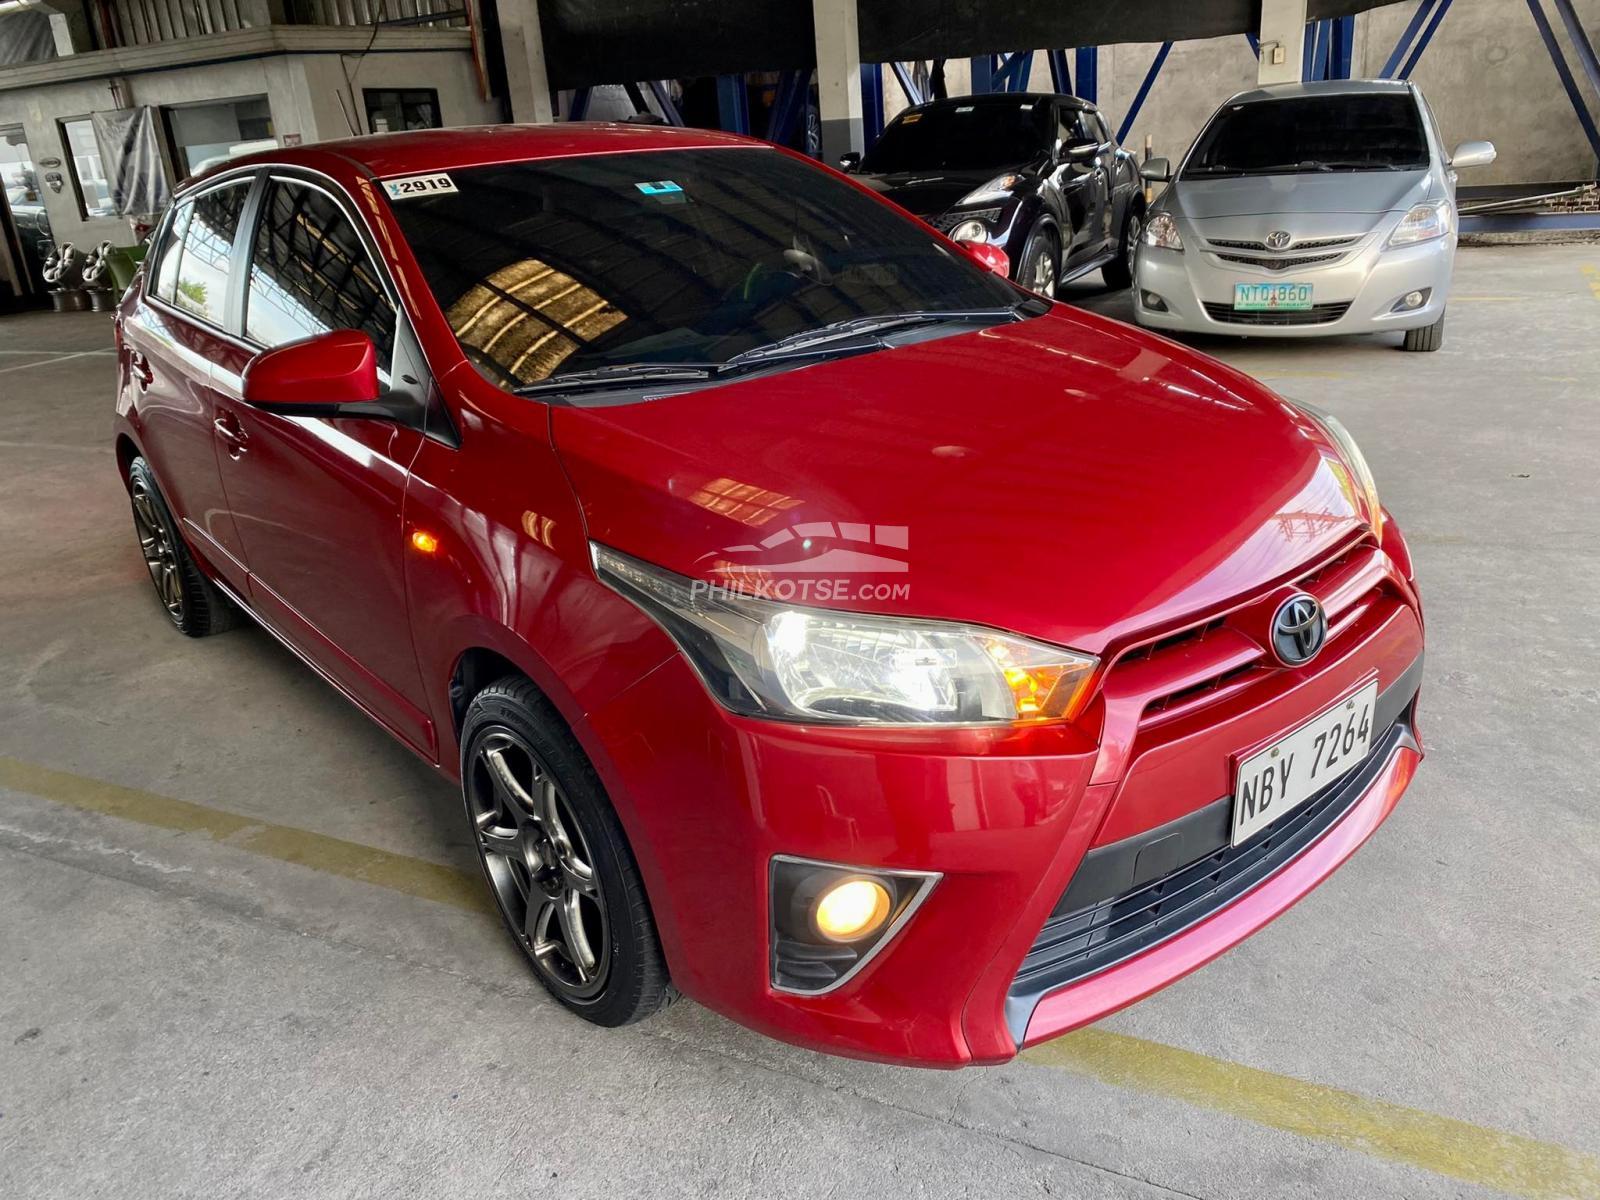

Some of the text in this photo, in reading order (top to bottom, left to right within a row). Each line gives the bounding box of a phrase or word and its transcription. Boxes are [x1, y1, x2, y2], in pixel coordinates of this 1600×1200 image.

[399, 177, 453, 194] 2919
[1278, 286, 1308, 302] 860
[1239, 703, 1370, 826] NBY 7264
